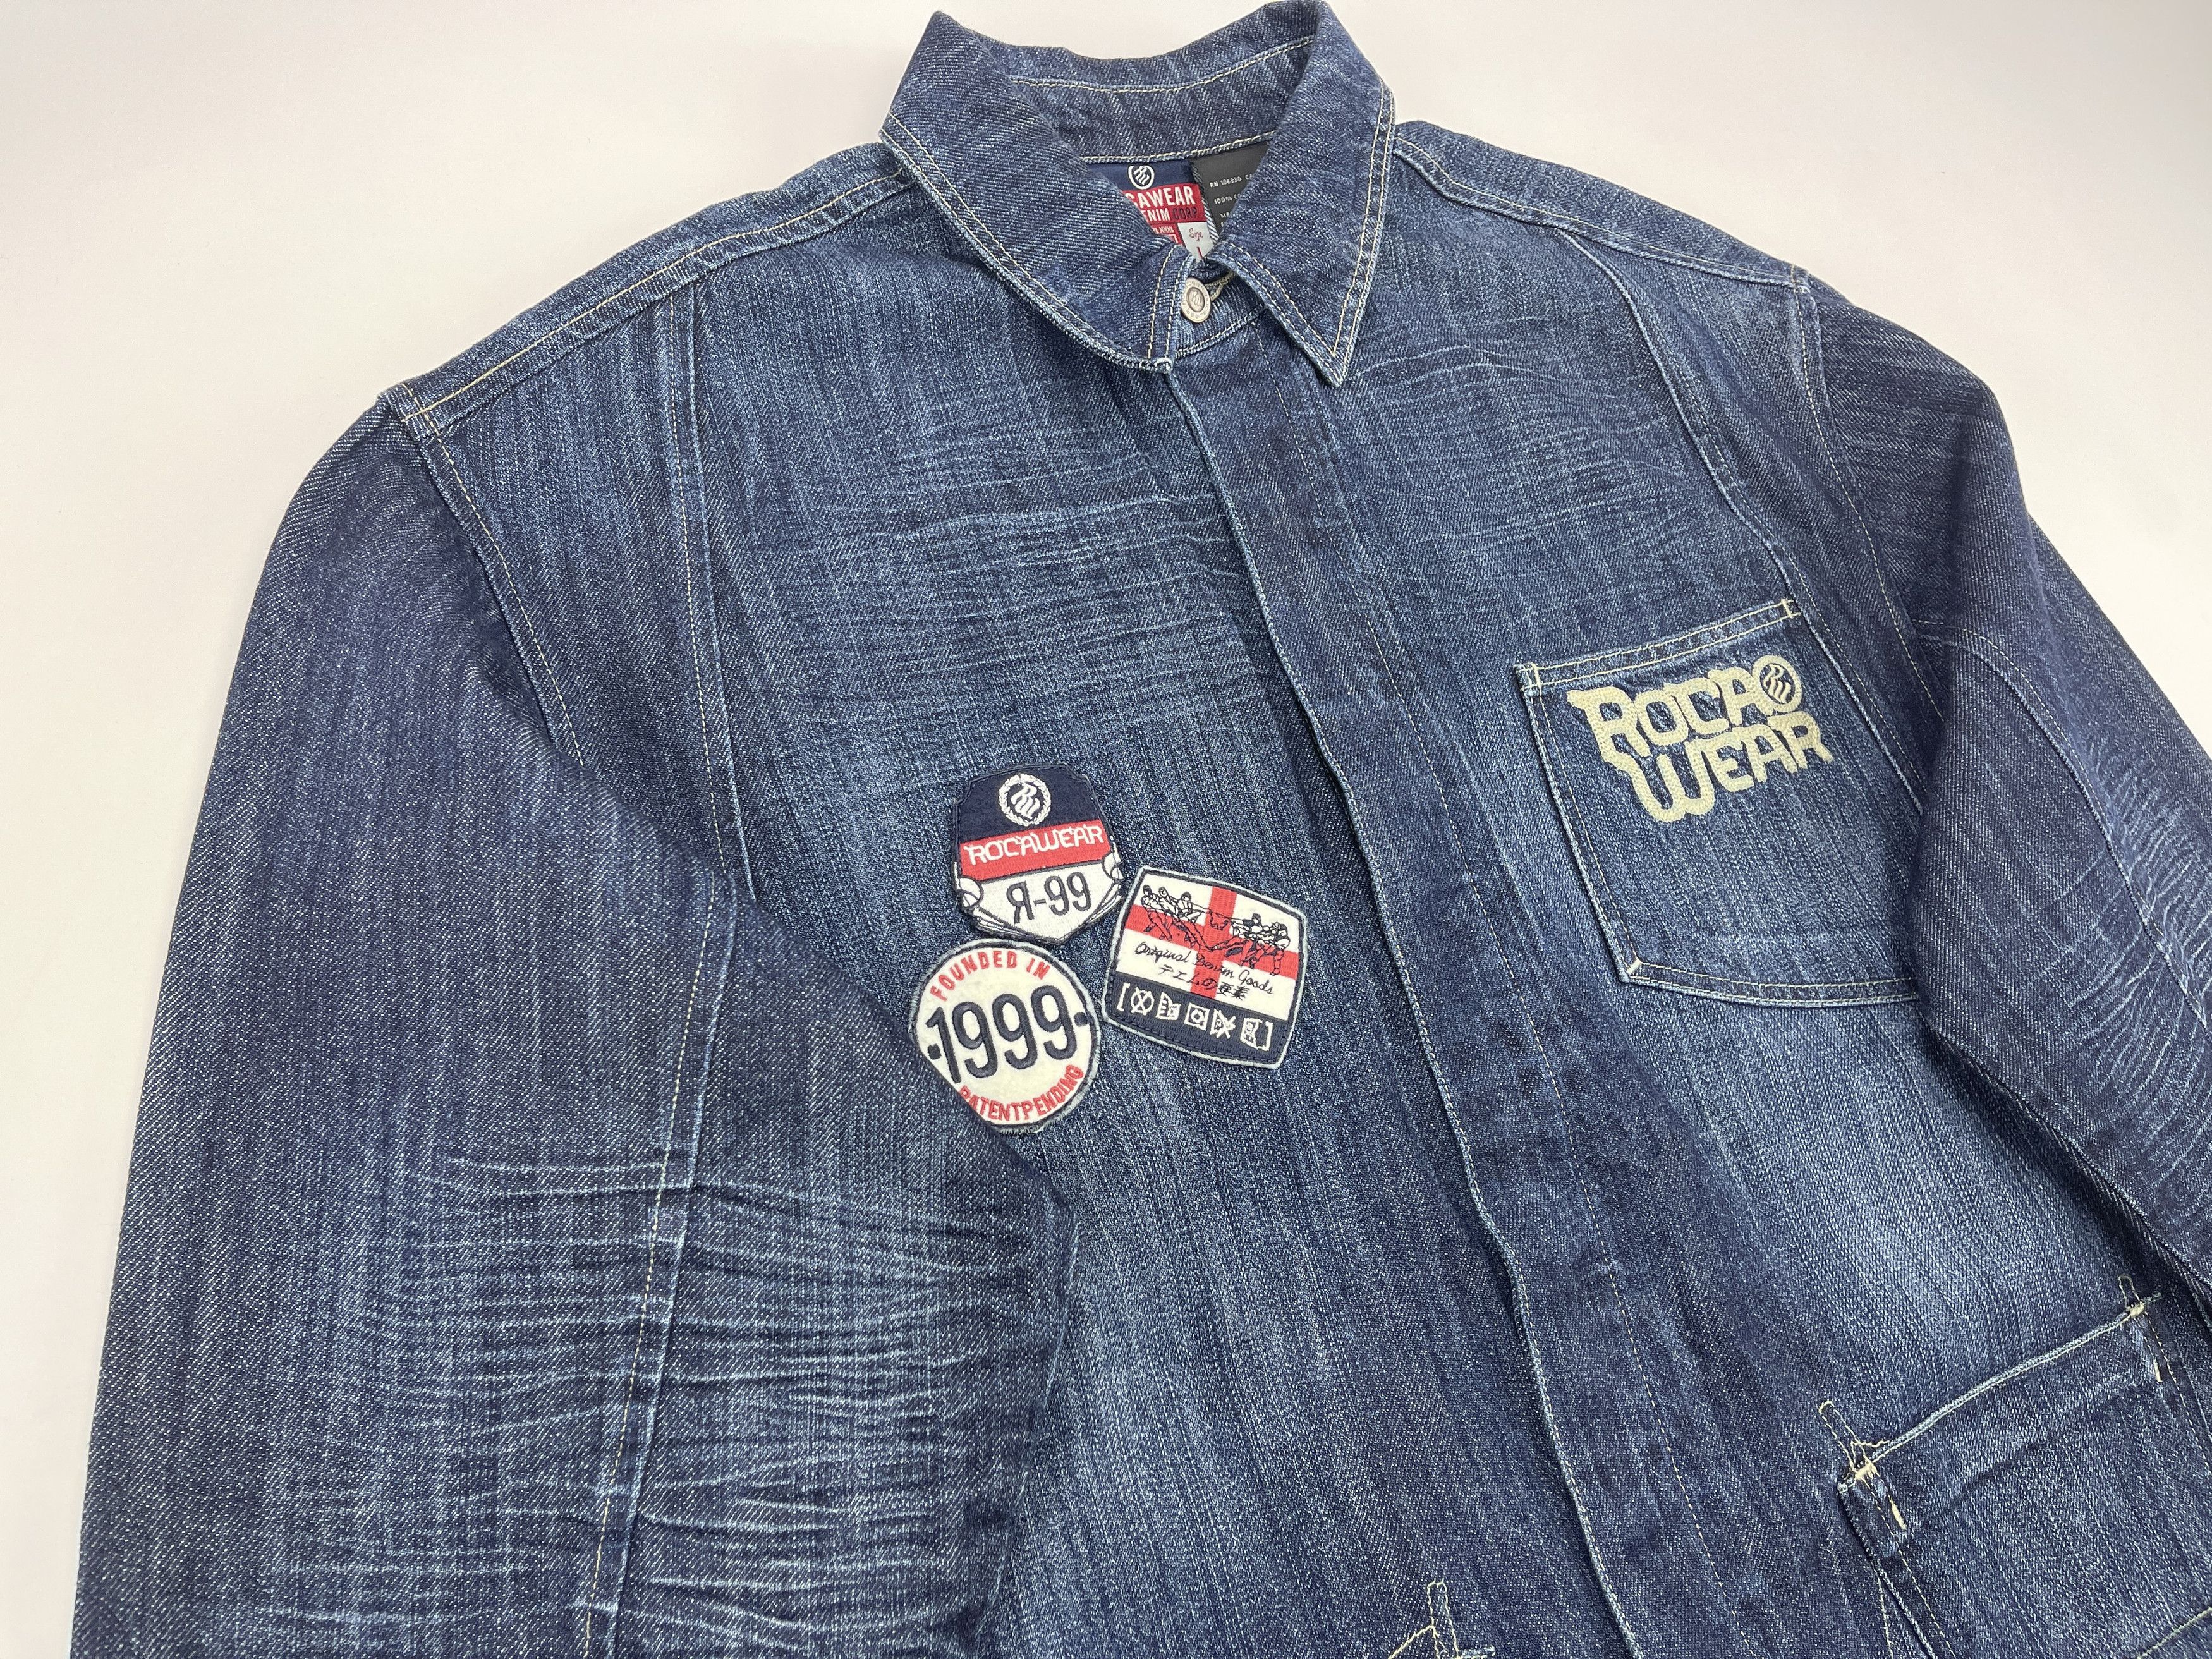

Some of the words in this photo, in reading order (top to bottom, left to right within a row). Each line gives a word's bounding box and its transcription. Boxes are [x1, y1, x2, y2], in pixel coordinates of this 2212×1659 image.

[1172, 207, 1197, 220] CORP
[1214, 197, 1233, 205] 100%
[1567, 666, 1773, 761] ROCA
[1612, 711, 1833, 822] WEAR
[964, 824, 1104, 865] ROCAWEAR
[930, 950, 1018, 1002] FOUNDED
[1026, 957, 1051, 980] IN
[1134, 941, 1191, 963] Original
[1238, 969, 1273, 994] Goods
[925, 985, 1078, 1084] 1999
